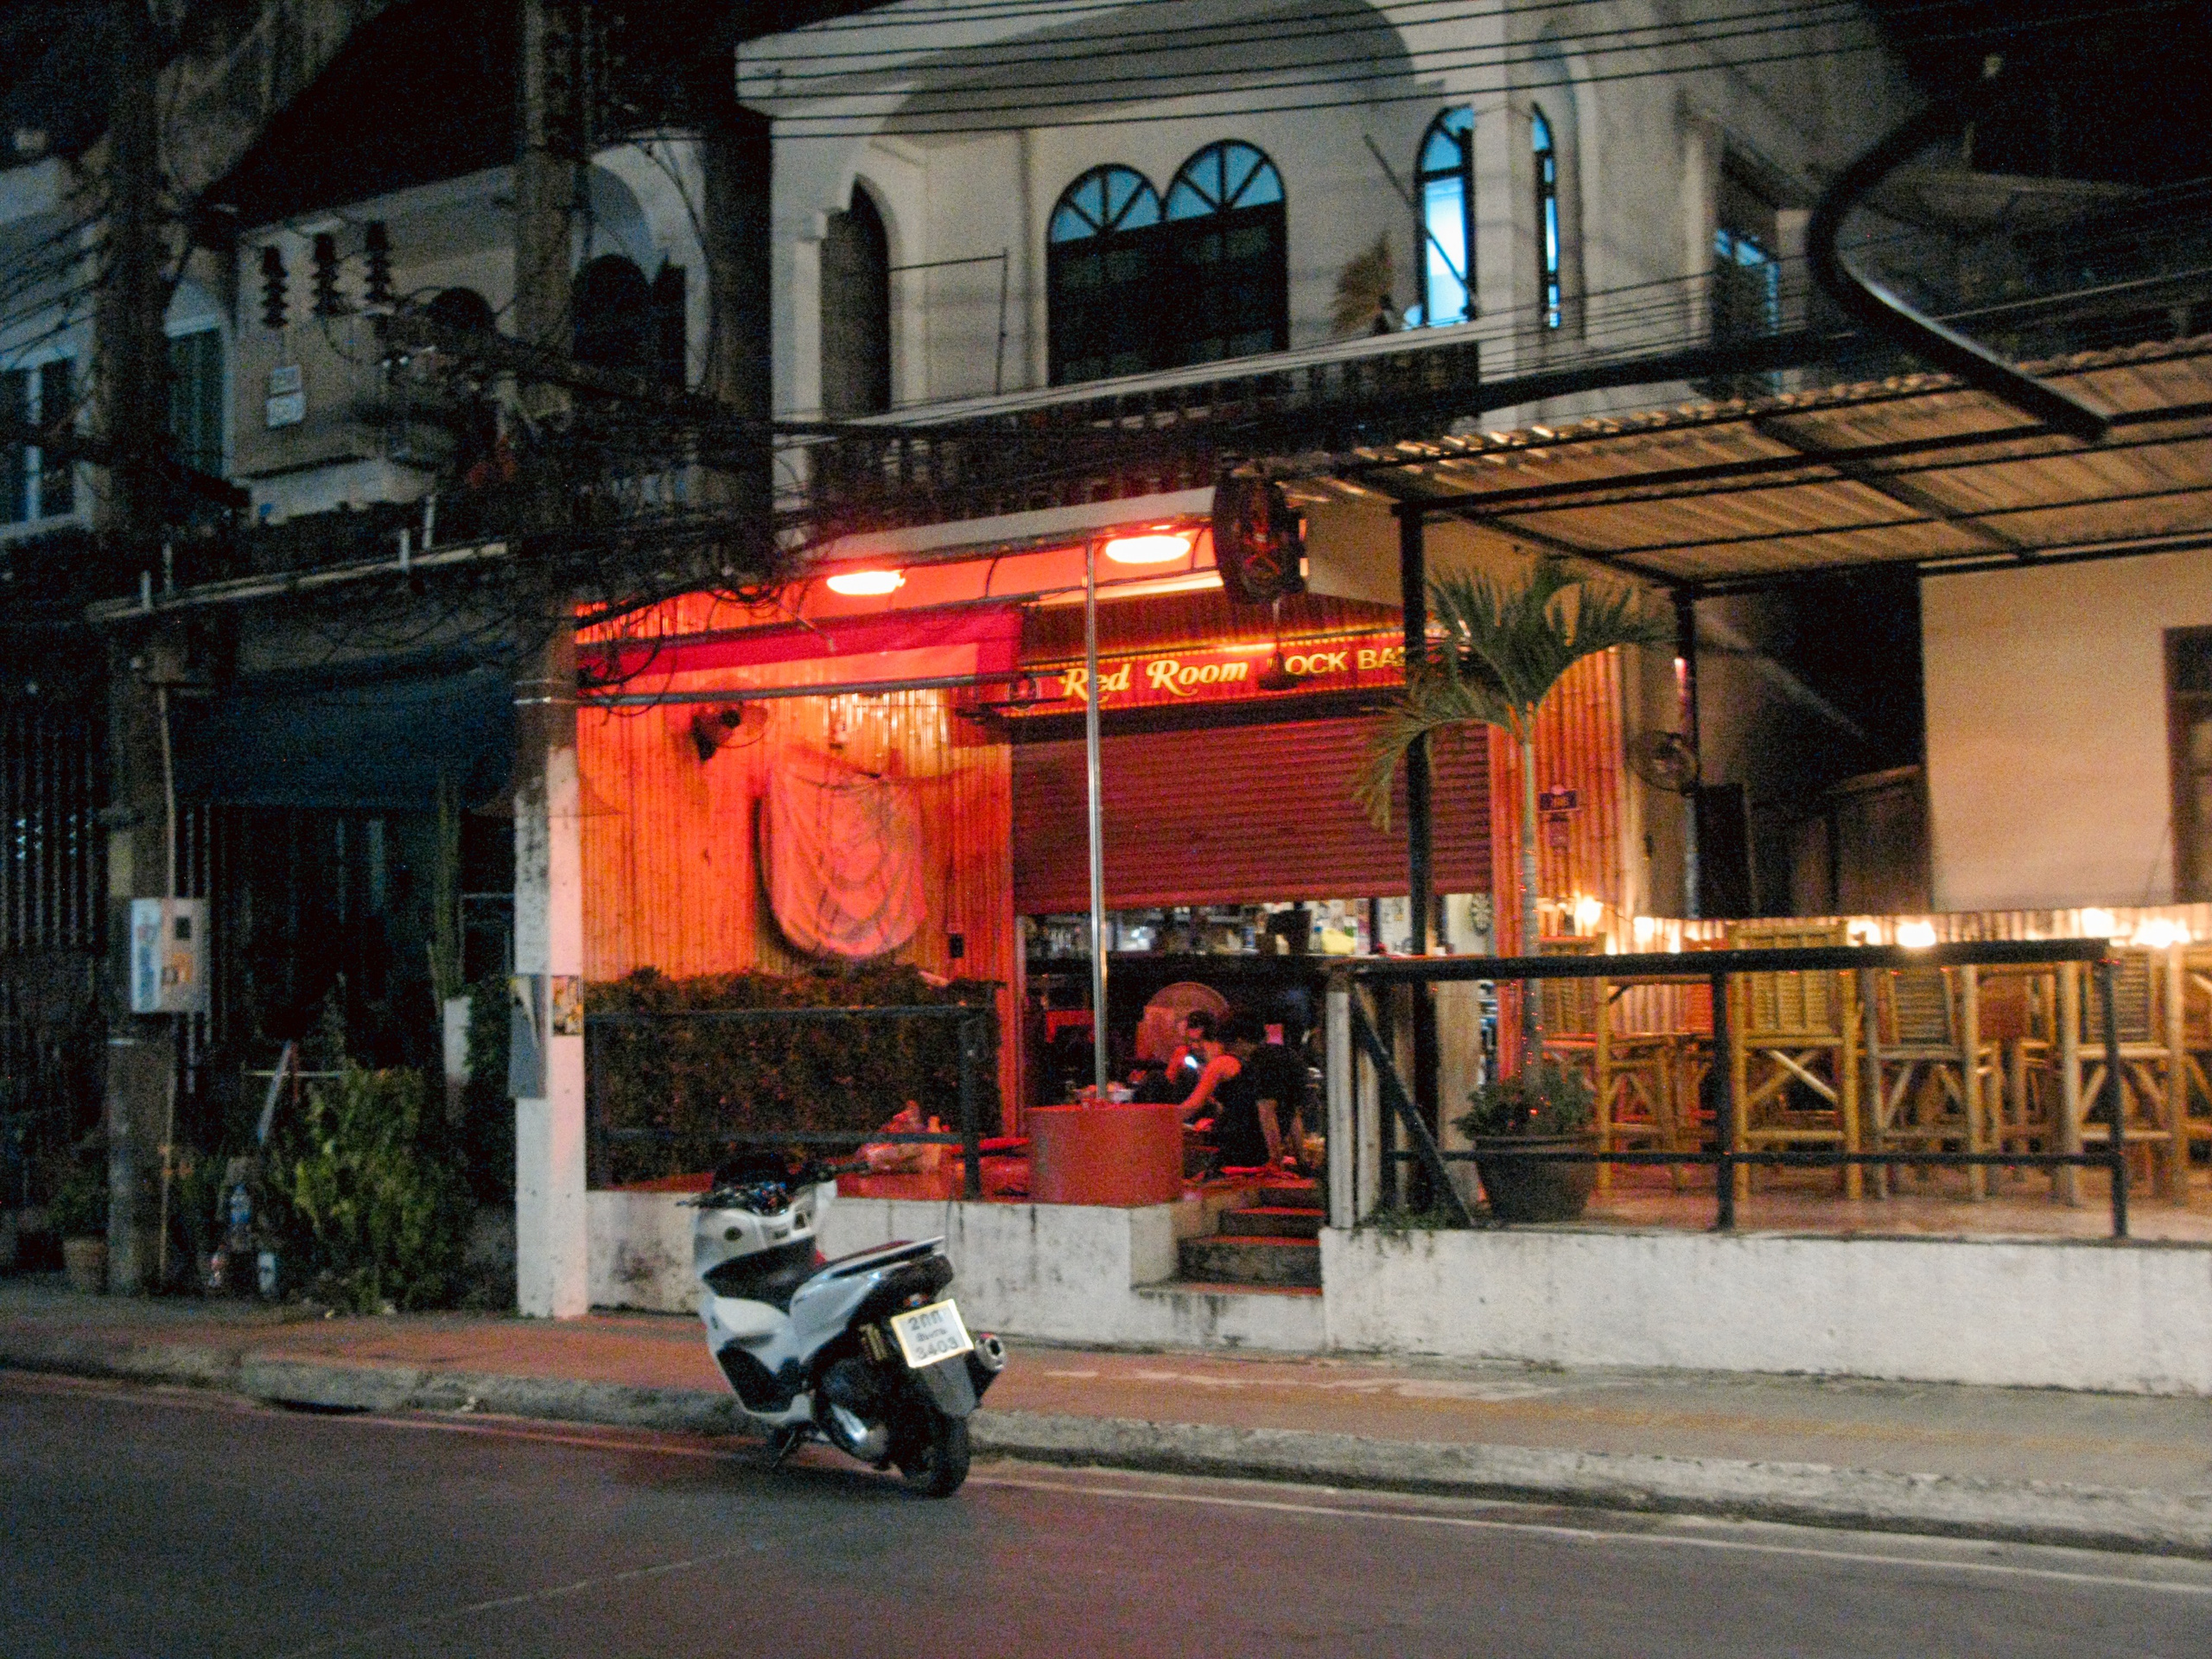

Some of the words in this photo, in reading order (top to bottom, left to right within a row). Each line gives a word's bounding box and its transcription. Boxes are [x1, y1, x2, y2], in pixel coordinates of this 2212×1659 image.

[1058, 664, 1131, 704] Red
[1146, 659, 1249, 696] Room
[1267, 651, 1349, 676] OCK
